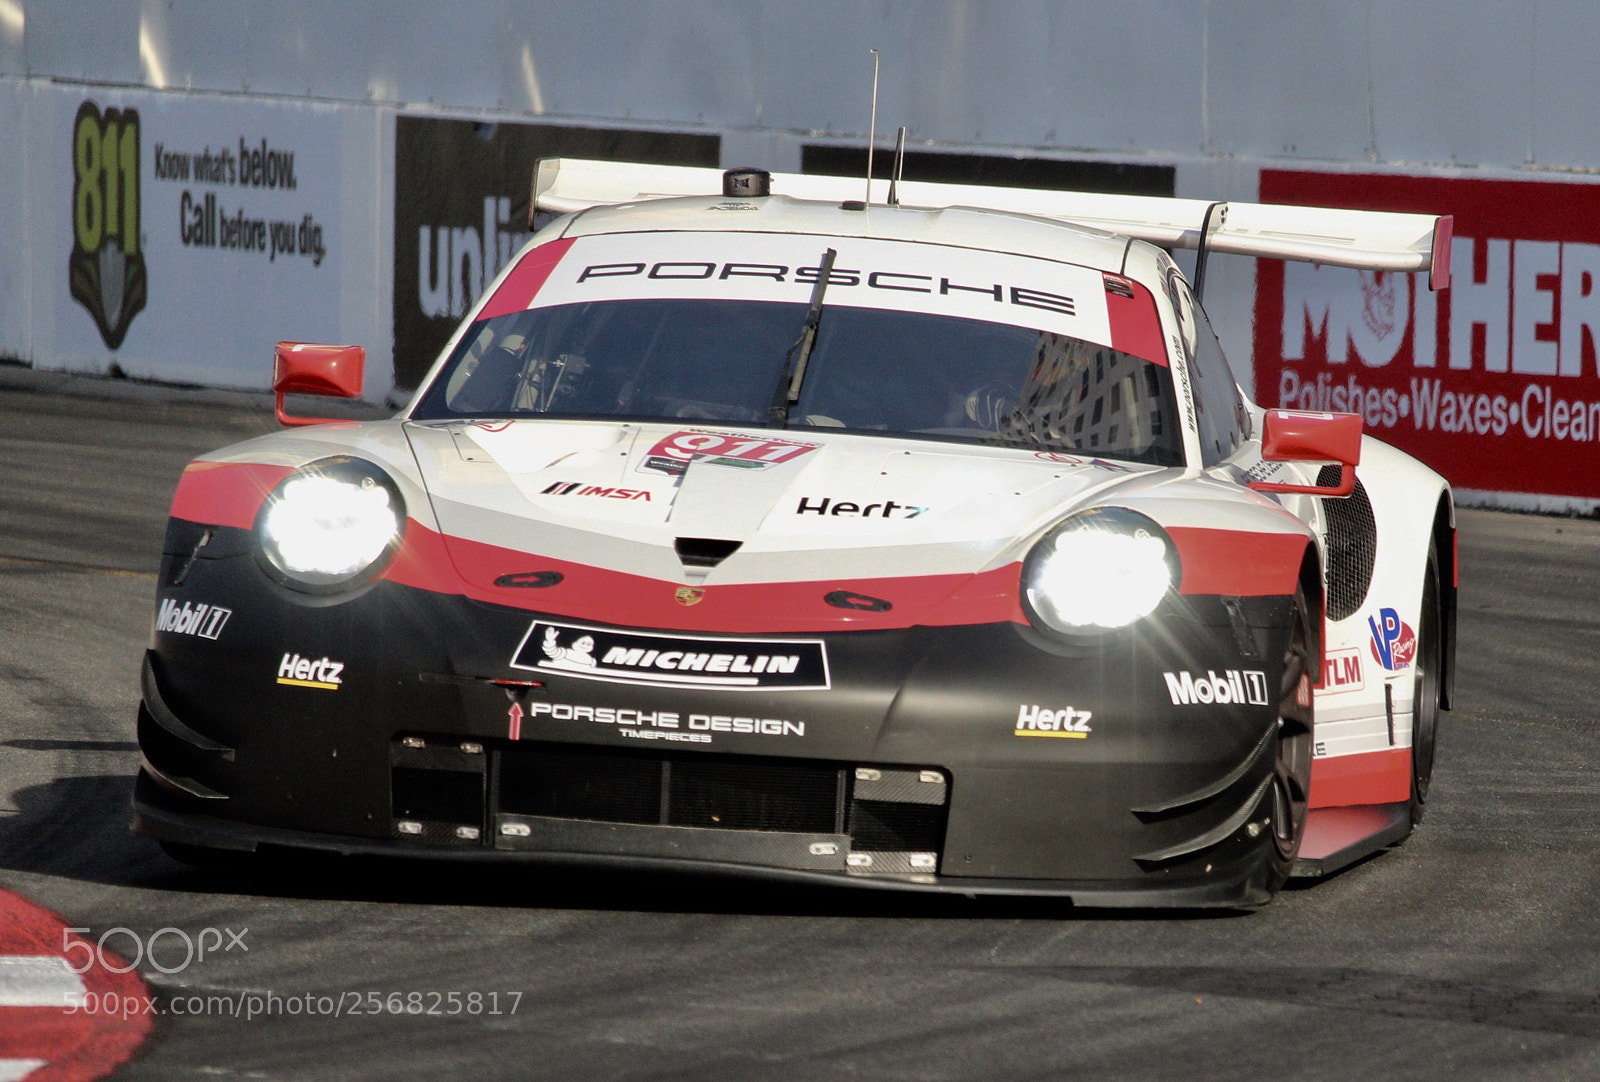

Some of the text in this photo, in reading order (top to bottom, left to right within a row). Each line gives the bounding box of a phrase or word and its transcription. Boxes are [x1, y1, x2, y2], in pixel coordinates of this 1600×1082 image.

[155, 136, 297, 189] Know what's below.
[75, 108, 138, 254] 811
[181, 188, 216, 246] Call
[220, 207, 266, 251] before
[270, 219, 296, 263] you
[419, 195, 534, 319] unli
[577, 262, 1076, 316] PORSCHE
[664, 434, 802, 460] 911
[577, 486, 651, 502] IMSA
[797, 497, 929, 519] Hertz
[156, 598, 208, 635] Mobil
[1368, 607, 1401, 671] VP
[277, 652, 344, 684] Hertz
[601, 646, 800, 674] MICHELIN
[1163, 670, 1244, 706] Mobil
[530, 702, 805, 736] PORSCHE DESIGN
[618, 727, 713, 744] TIMEPIECES
[1016, 704, 1092, 732] Hertz
